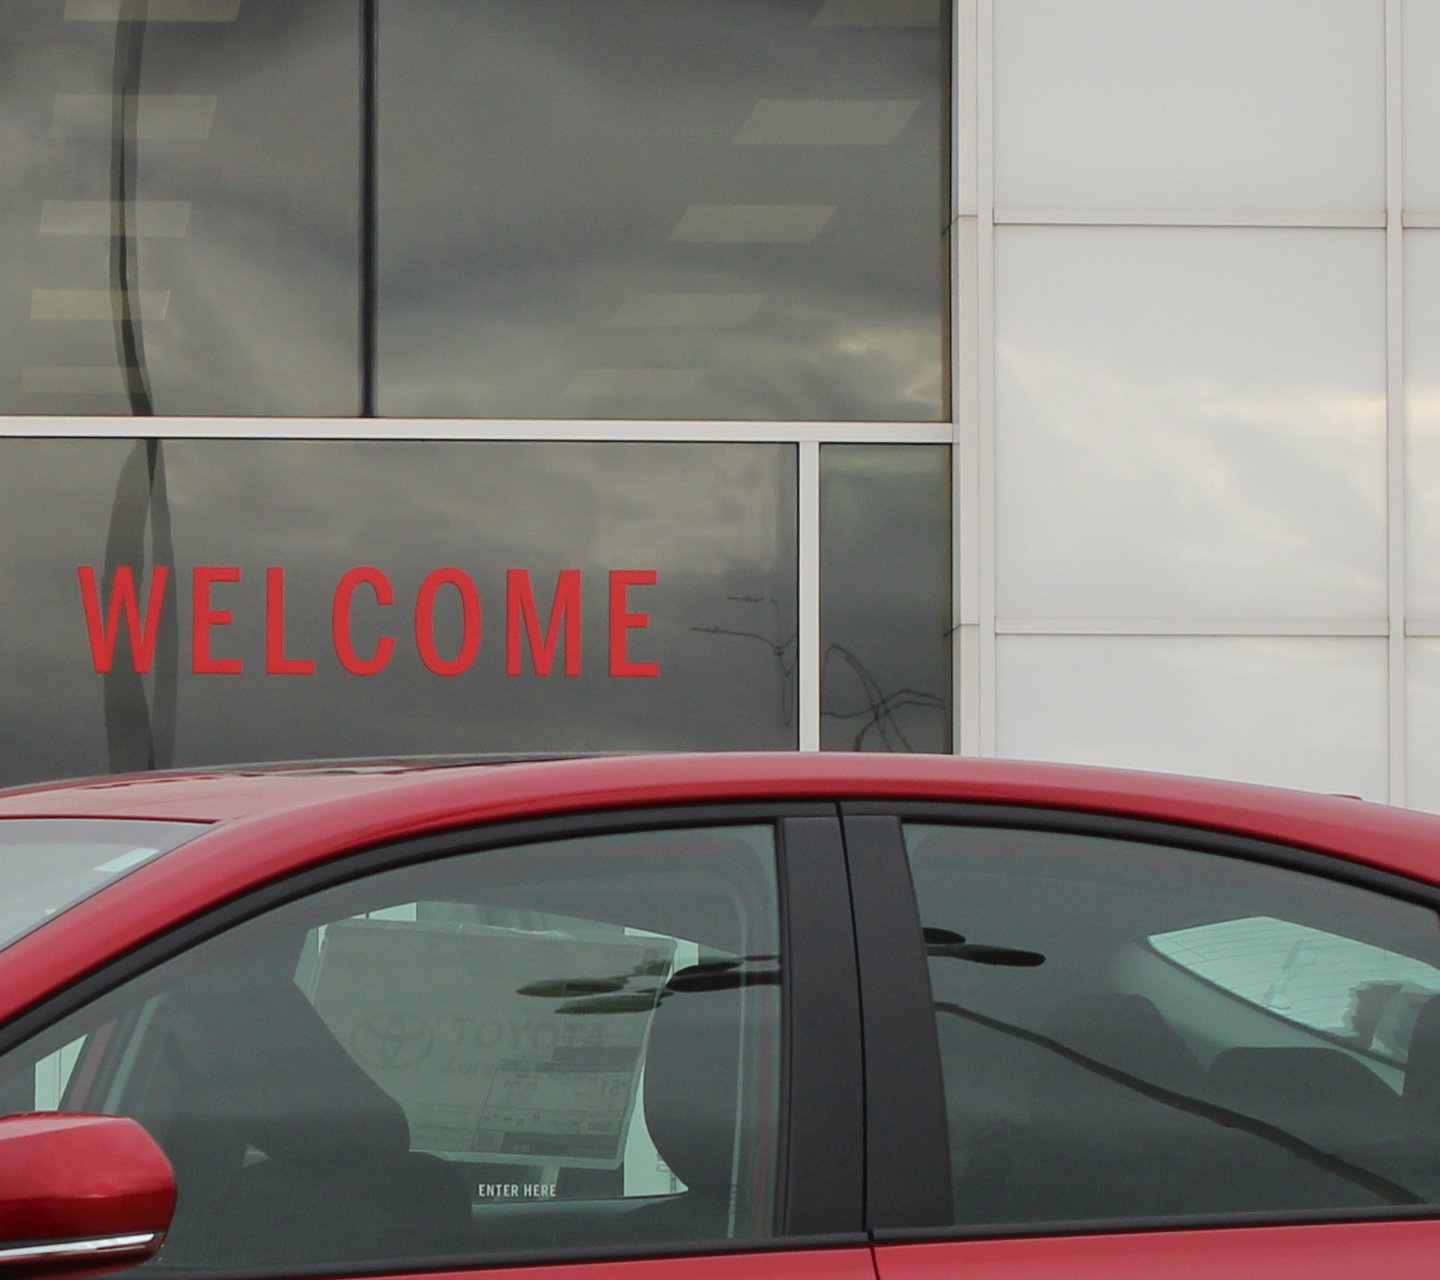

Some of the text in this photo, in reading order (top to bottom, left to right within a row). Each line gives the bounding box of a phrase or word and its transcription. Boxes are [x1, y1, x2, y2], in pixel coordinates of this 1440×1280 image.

[77, 564, 662, 679] WELCOME
[478, 1183, 557, 1197] ENTER HERE
